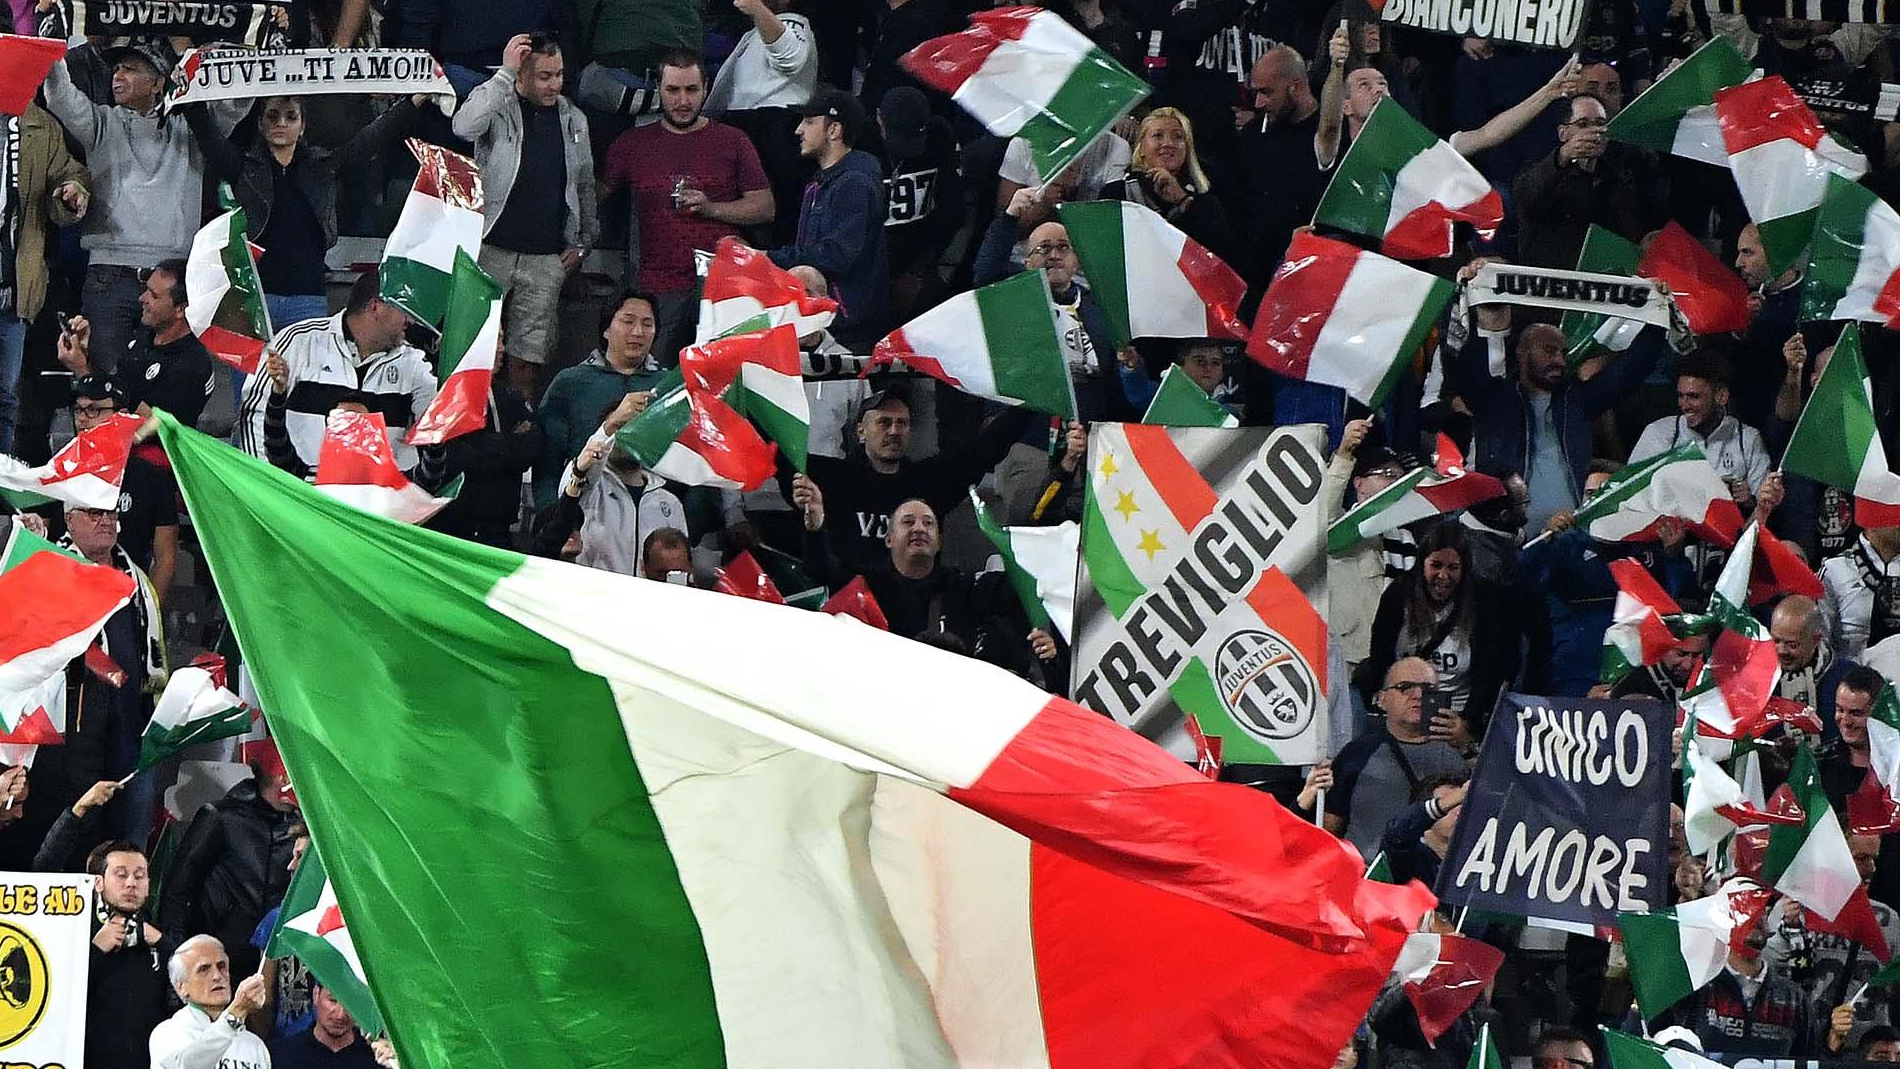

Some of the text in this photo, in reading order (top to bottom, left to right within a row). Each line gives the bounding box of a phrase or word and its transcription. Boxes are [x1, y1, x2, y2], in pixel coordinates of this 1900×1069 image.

[99, 0, 239, 28] JUVENTUS
[198, 61, 277, 87] JUVE
[343, 57, 433, 82] AMO!!!
[1494, 272, 1651, 310] JUVENTUS
[1075, 433, 1323, 720] TREVIGLIO
[1224, 642, 1283, 696] JUVENTUS
[1515, 705, 1649, 788] UNICO
[1456, 816, 1652, 914] AMORE
[43, 884, 85, 916] AL
